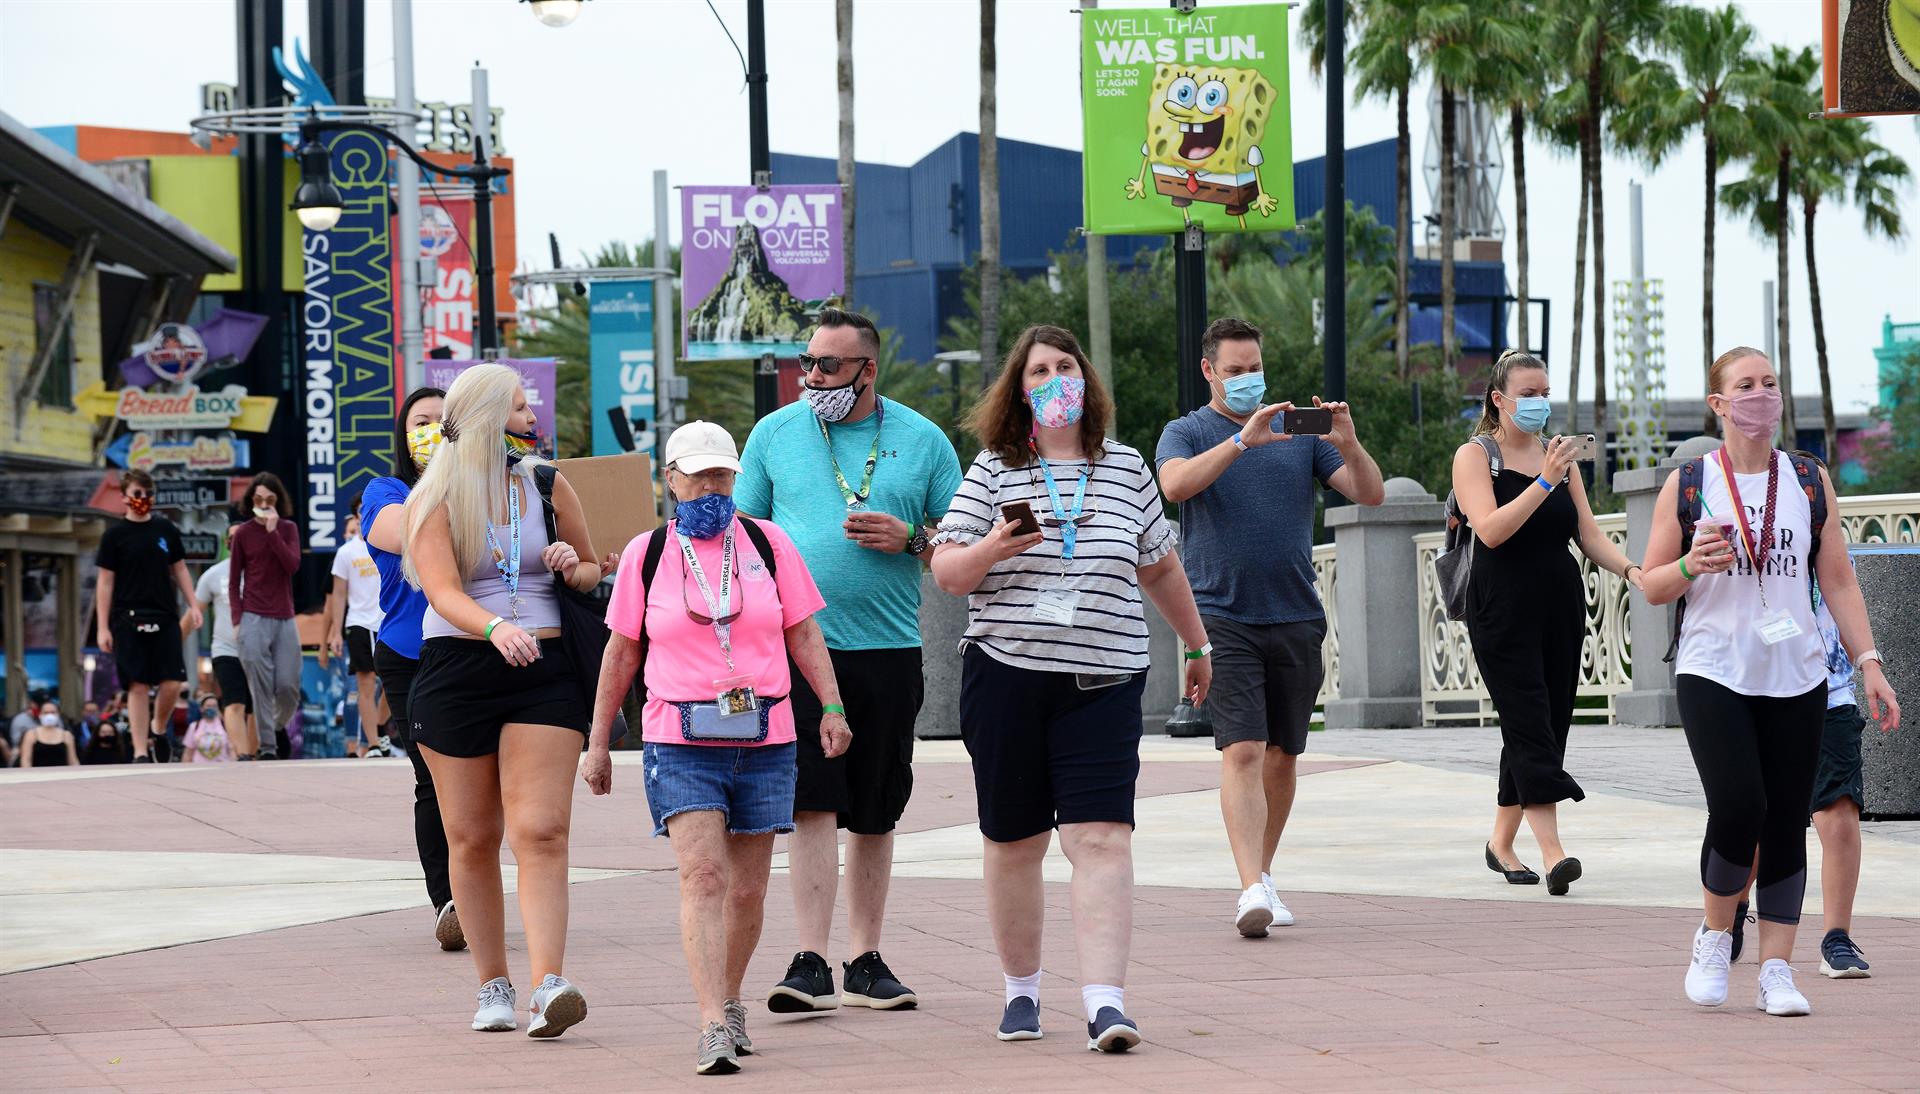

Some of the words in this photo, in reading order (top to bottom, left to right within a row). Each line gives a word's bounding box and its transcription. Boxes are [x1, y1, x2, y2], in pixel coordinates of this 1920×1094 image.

[1094, 17, 1162, 38] WELL,
[1163, 16, 1217, 35] THAT
[1095, 38, 1178, 66] WAS
[1184, 35, 1265, 62] FUN.
[1095, 69, 1122, 78] LET'S
[1123, 69, 1140, 78] DO
[1096, 79, 1105, 88] IT
[1107, 79, 1138, 87] AGAIN
[1096, 88, 1129, 97] SOON.
[692, 193, 836, 229] FLOAT
[692, 228, 731, 250] ON
[762, 228, 830, 249] OVER
[771, 250, 781, 258] TO
[774, 257, 811, 265] VOLCANO
[812, 257, 828, 265] BAY
[301, 233, 333, 353] SAVOR
[330, 131, 396, 487] CITYWALK
[120, 390, 195, 416] Bread
[195, 399, 236, 413] BOX
[306, 359, 334, 467] MORE
[308, 472, 337, 549] FUN
[684, 545, 694, 560] Love
[724, 535, 732, 562] STUDIOS
[722, 563, 730, 596] UNIVERSAL
